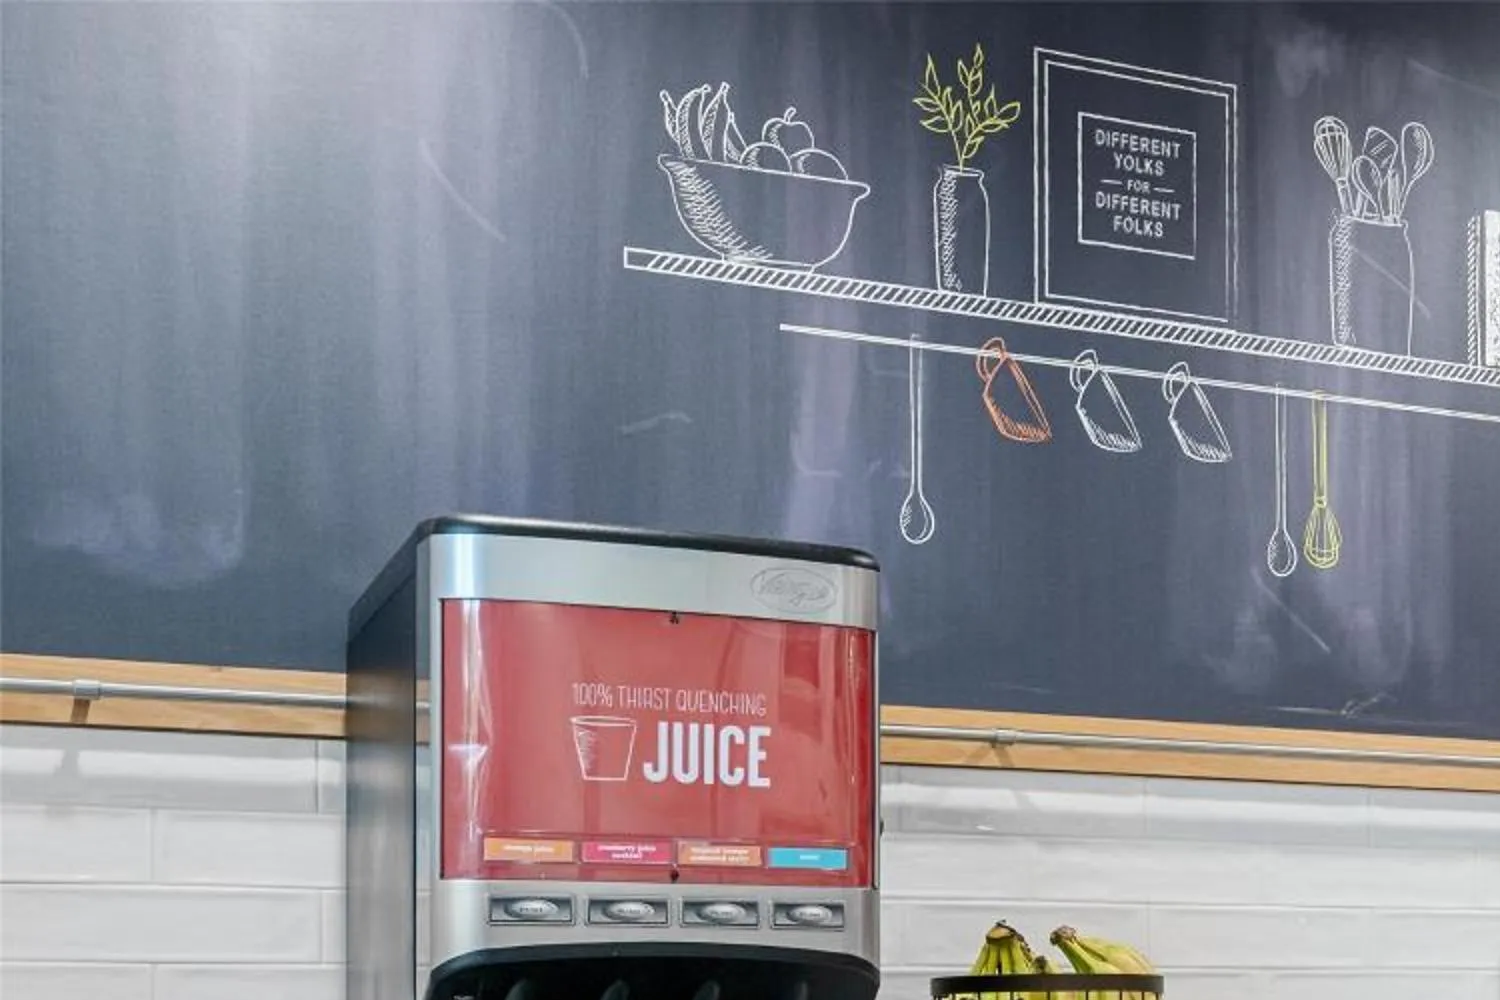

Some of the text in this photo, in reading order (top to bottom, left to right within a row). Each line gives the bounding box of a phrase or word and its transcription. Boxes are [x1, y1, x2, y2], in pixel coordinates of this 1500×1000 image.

[1095, 128, 1181, 158] DIFFERENT
[1113, 153, 1164, 177] YOLKS
[1127, 179, 1150, 193] FOR
[1095, 191, 1181, 220] DIFFERENT
[1113, 215, 1163, 238] FOLKS
[573, 682, 767, 717] 100% THIRST QUENCHING
[643, 720, 771, 788] JUICE
